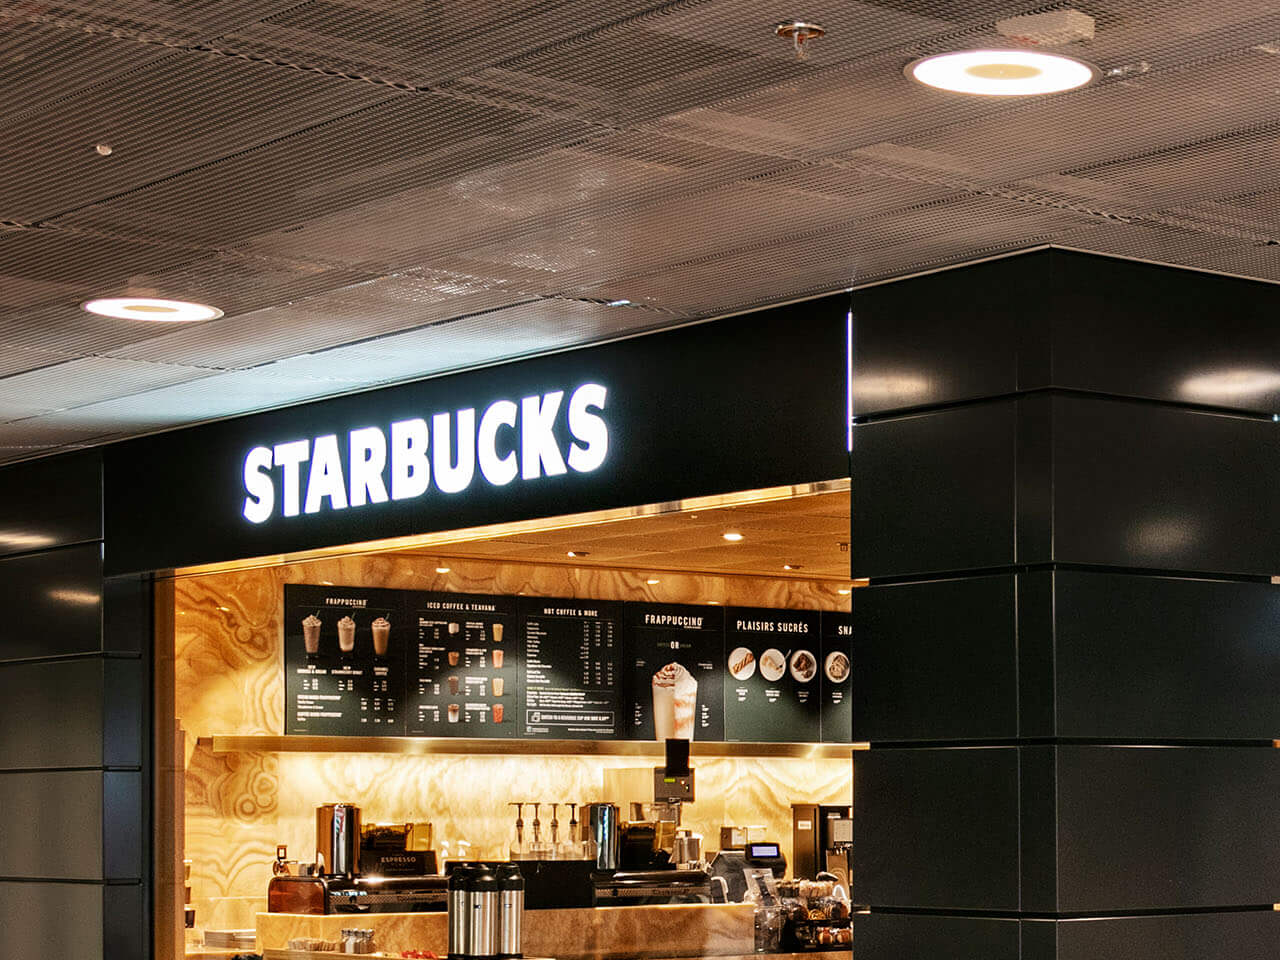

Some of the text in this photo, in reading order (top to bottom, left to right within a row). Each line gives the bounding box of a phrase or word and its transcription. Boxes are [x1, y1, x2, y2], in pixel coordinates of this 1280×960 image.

[243, 383, 608, 524] STARBUCKS
[325, 598, 367, 606] FRAPPUCCINO
[442, 602, 464, 610] COFFEE
[555, 608, 576, 616] COFFEE
[645, 614, 703, 626] FRAPPUCCINO
[736, 620, 809, 633] PLAISIRS SUCRÉS
